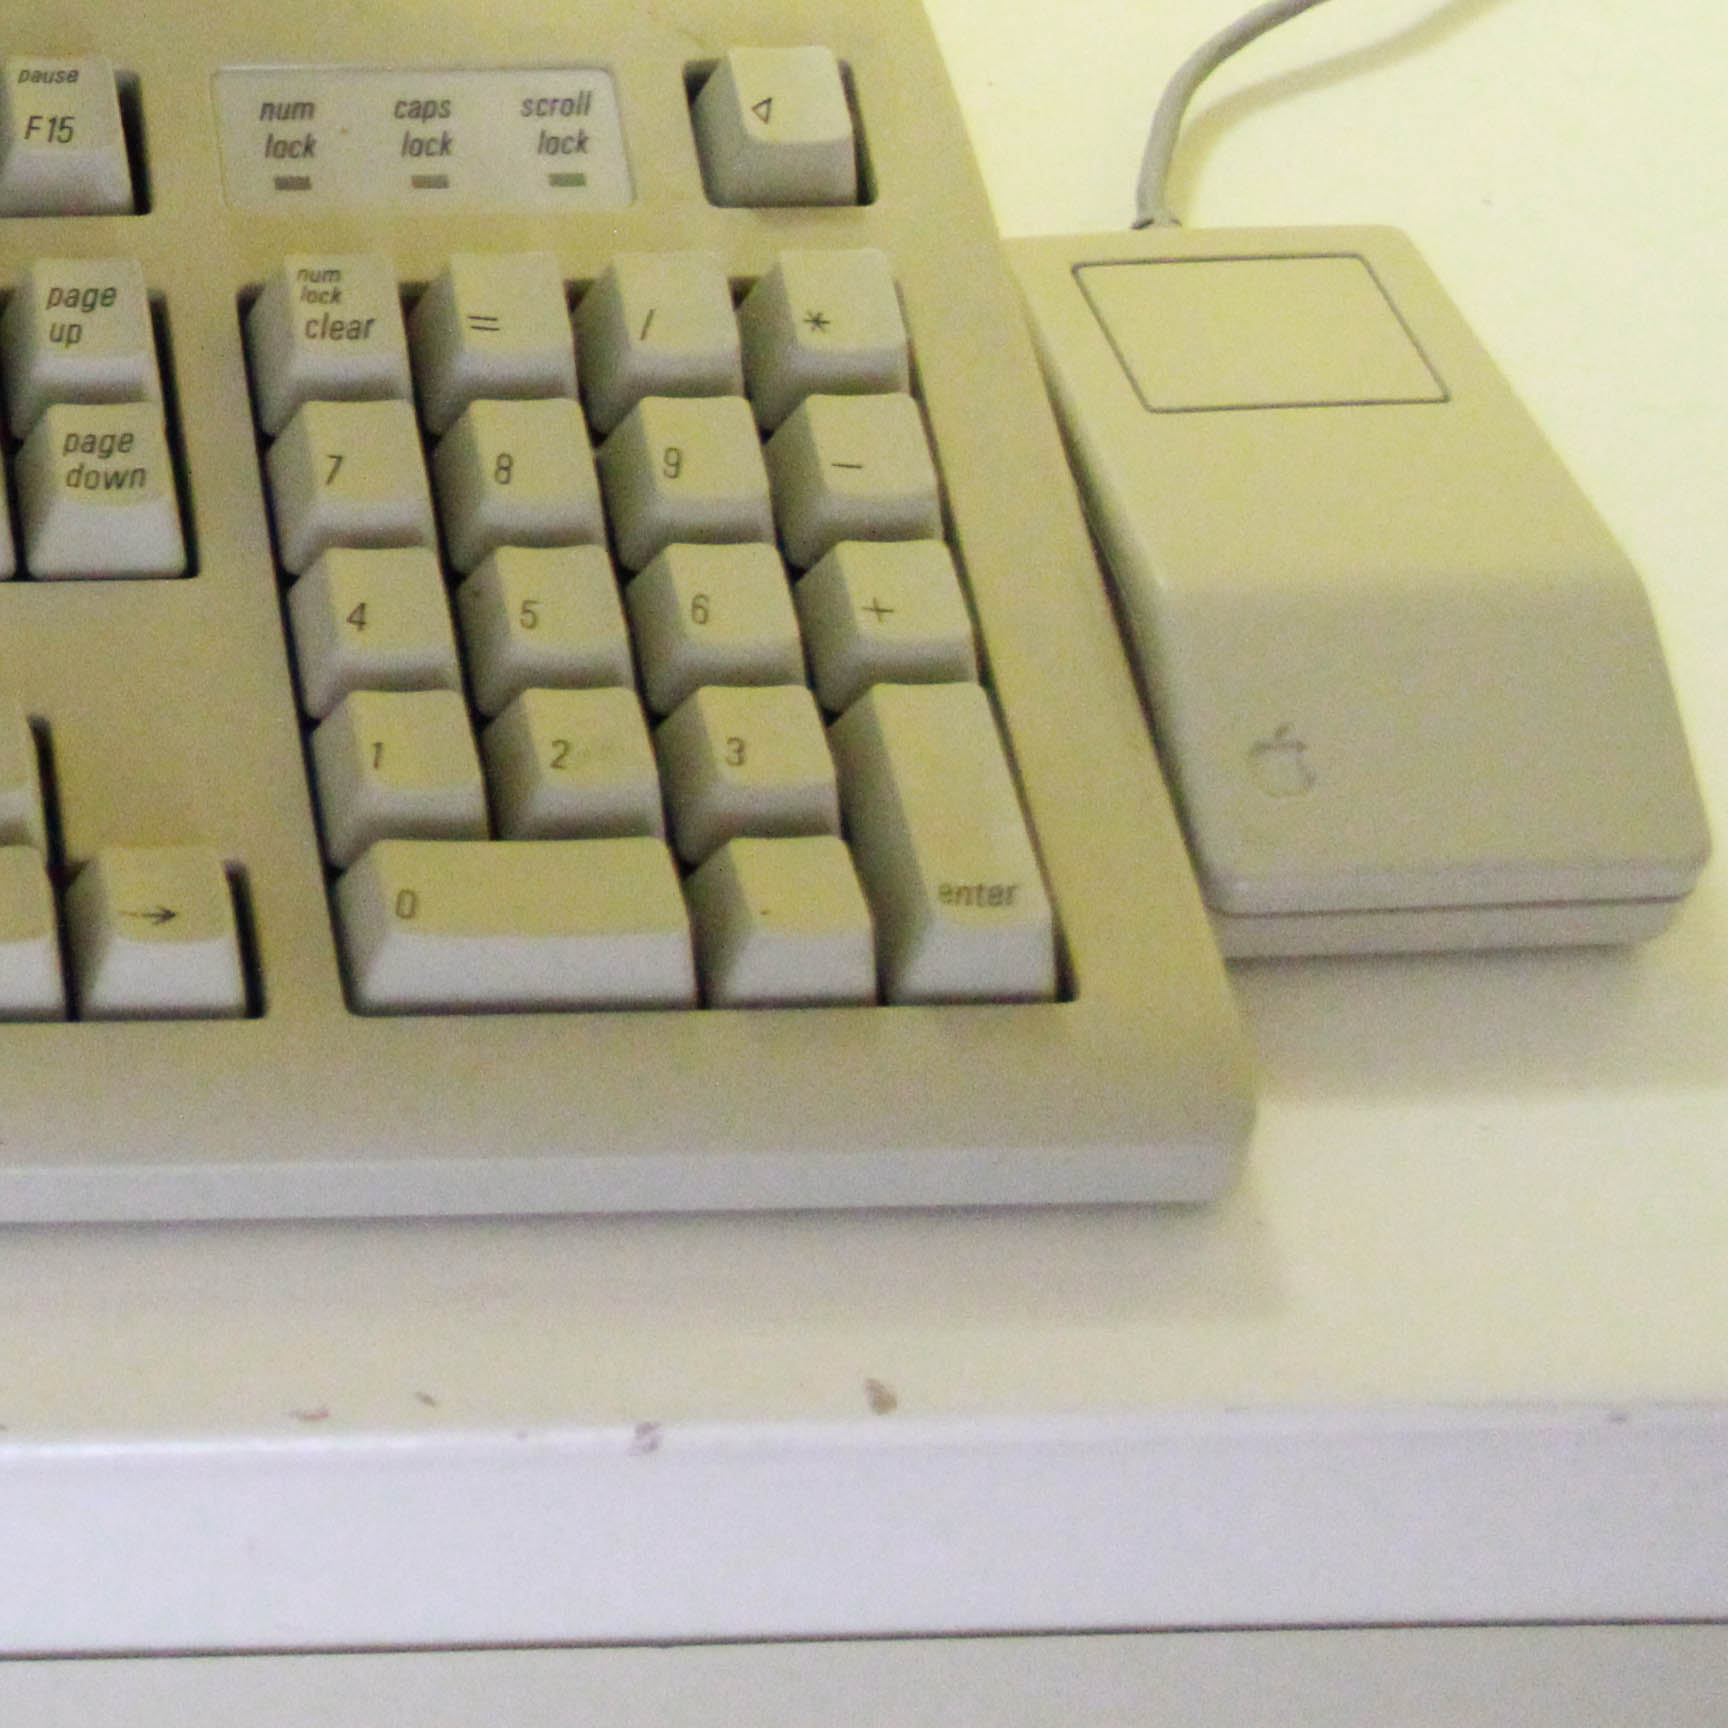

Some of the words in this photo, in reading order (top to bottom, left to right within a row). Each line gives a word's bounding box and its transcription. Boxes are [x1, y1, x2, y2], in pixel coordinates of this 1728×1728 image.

[18, 68, 79, 86] pause
[259, 98, 315, 120] num
[394, 96, 452, 122] caps
[521, 90, 592, 118] scroll
[25, 116, 76, 144] F15
[401, 130, 453, 157] lock
[537, 128, 589, 155] lock
[265, 132, 317, 159] lock
[46, 283, 117, 311] page
[300, 286, 343, 305] lock
[48, 319, 82, 347] up
[306, 314, 375, 340] clear
[468, 314, 500, 332] =
[64, 430, 134, 457] page
[325, 454, 344, 485] 7
[495, 454, 514, 485] 8
[662, 448, 682, 478] 9
[66, 464, 146, 492] down
[346, 601, 367, 630] 4
[519, 600, 539, 629] 5
[692, 594, 711, 624] 6
[862, 596, 895, 622] +
[370, 742, 384, 768] 1
[551, 741, 570, 769] 2
[726, 738, 747, 766] 3
[937, 881, 1019, 907] enter
